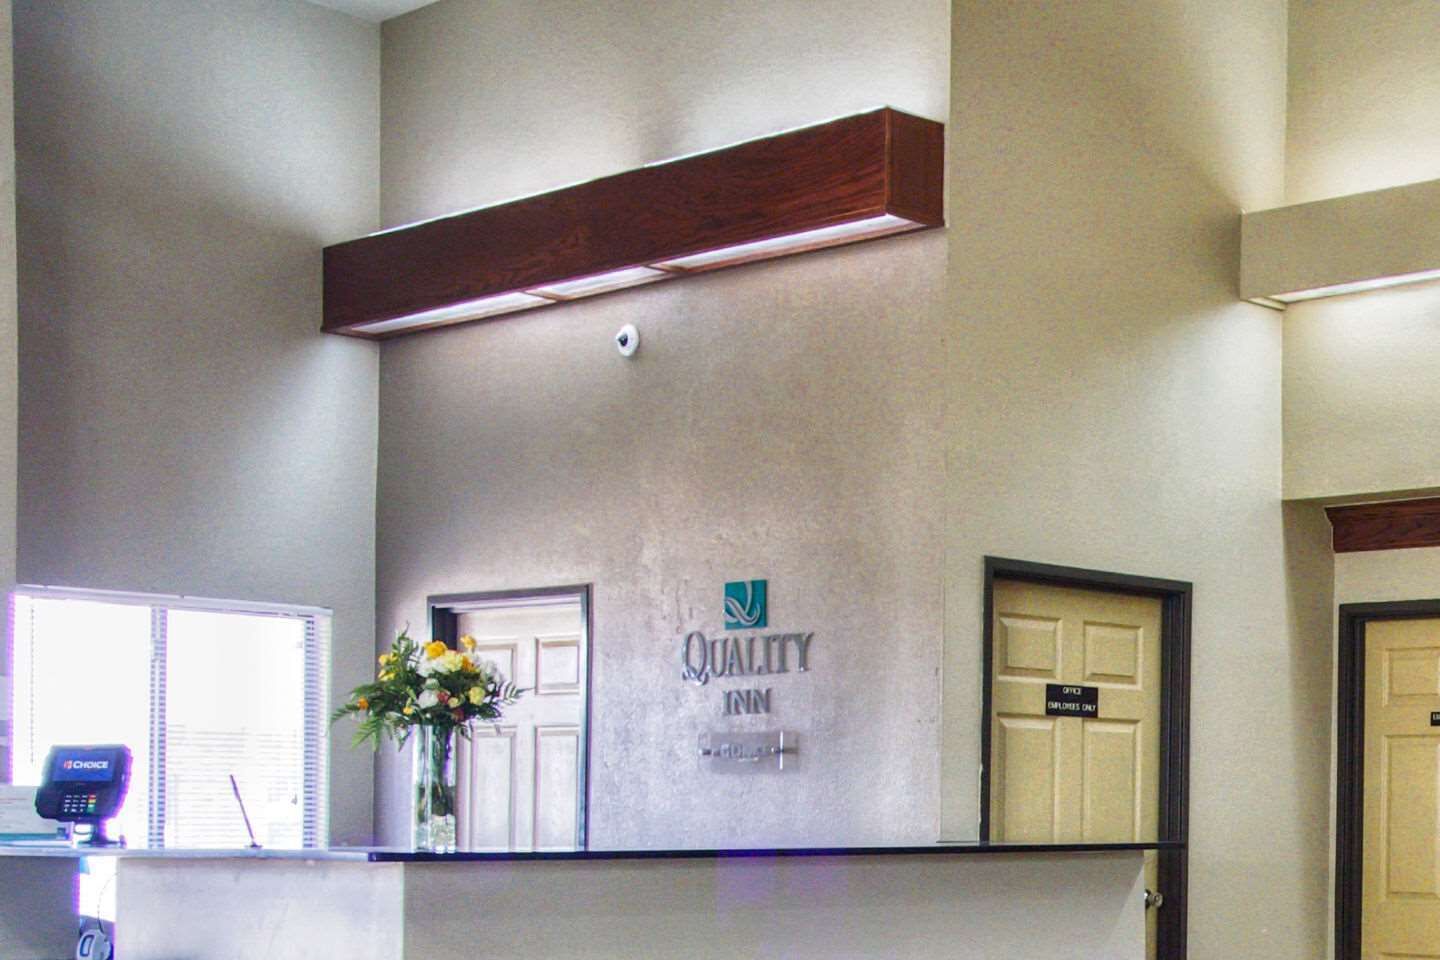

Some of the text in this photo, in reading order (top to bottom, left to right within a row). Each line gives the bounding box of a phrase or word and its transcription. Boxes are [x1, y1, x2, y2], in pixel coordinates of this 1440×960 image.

[682, 631, 815, 685] QUALITY
[723, 688, 772, 716] INN
[1047, 701, 1097, 712] EMPLOYEES ONLY
